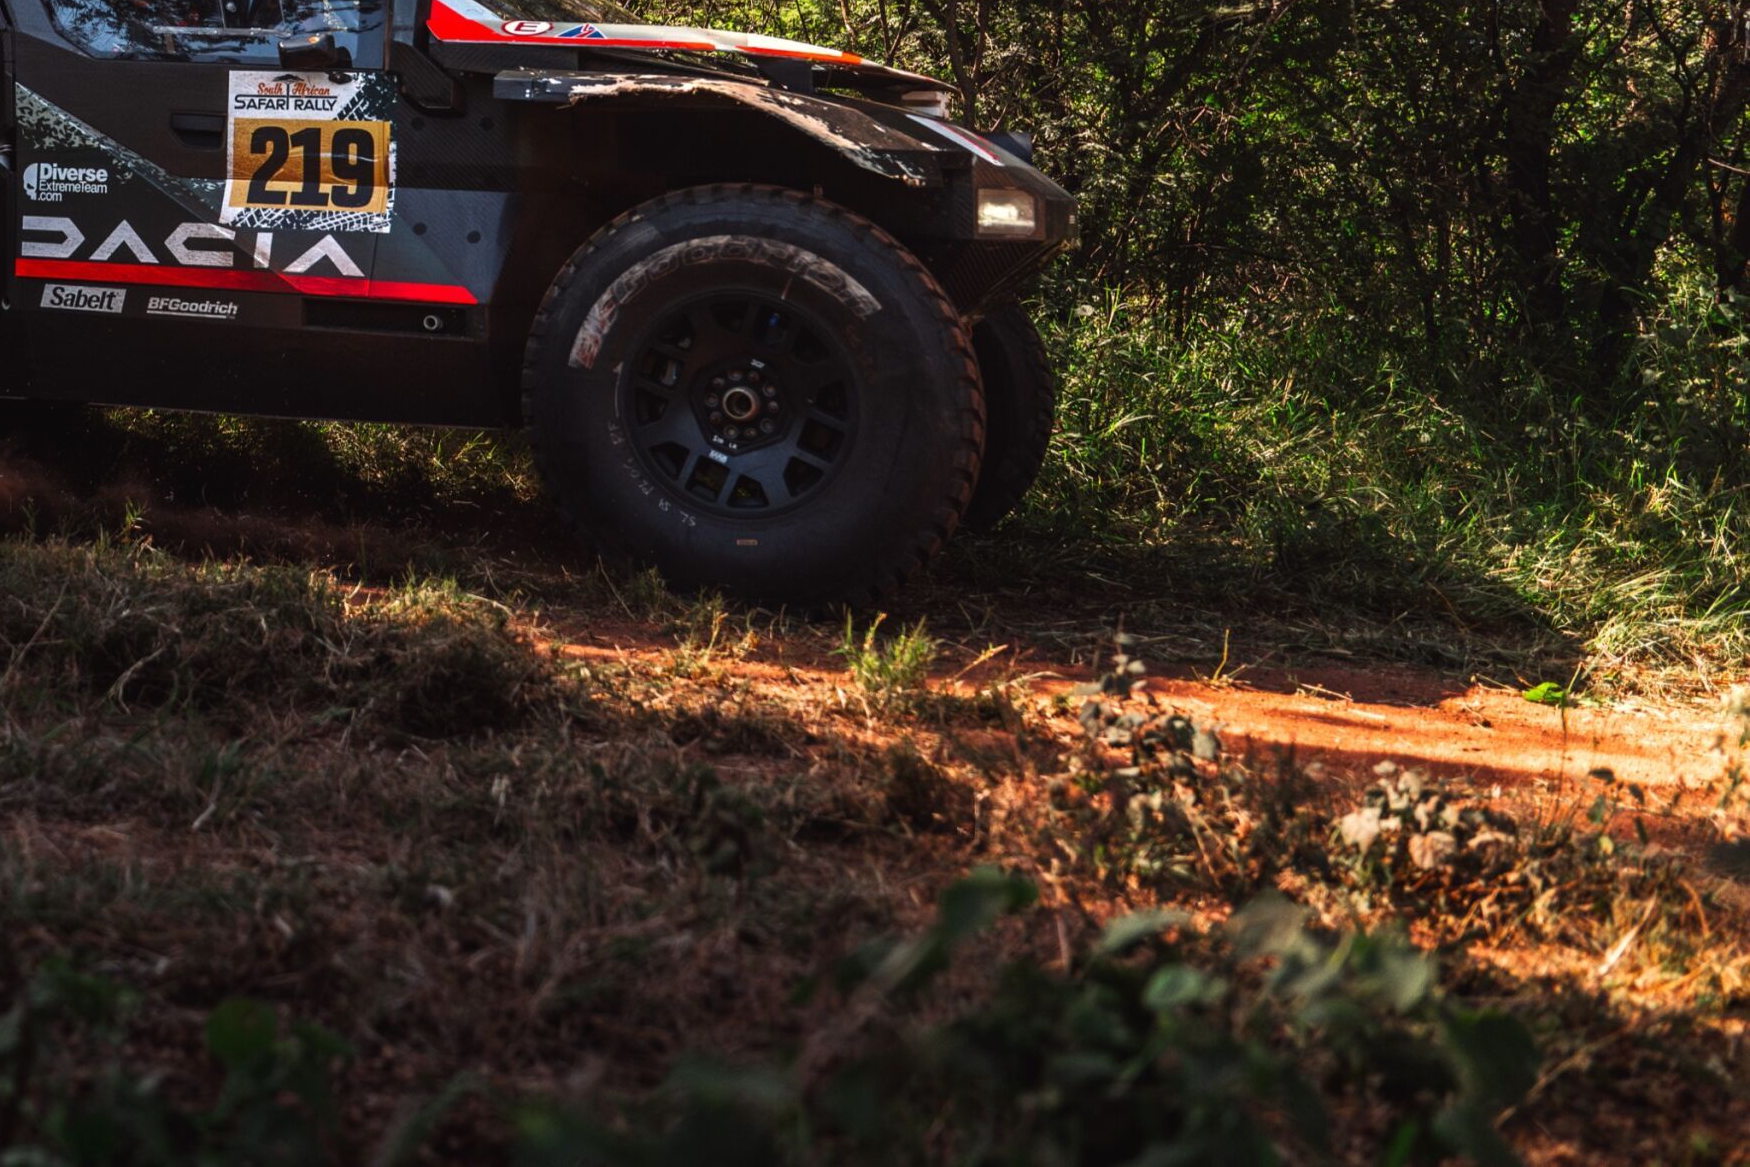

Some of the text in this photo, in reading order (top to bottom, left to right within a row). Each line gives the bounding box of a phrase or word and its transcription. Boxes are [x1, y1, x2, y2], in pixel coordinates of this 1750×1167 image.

[513, 21, 542, 32] E
[256, 81, 332, 98] South African
[234, 94, 338, 112] SAFARI RALLY
[39, 162, 109, 183] Diverse
[246, 125, 376, 209] 219
[38, 179, 108, 194] ExtremeTeam
[37, 192, 63, 202] .com
[21, 215, 366, 277] DACIA
[50, 286, 116, 311] Sabelt
[147, 296, 238, 315] BFGoodrich
